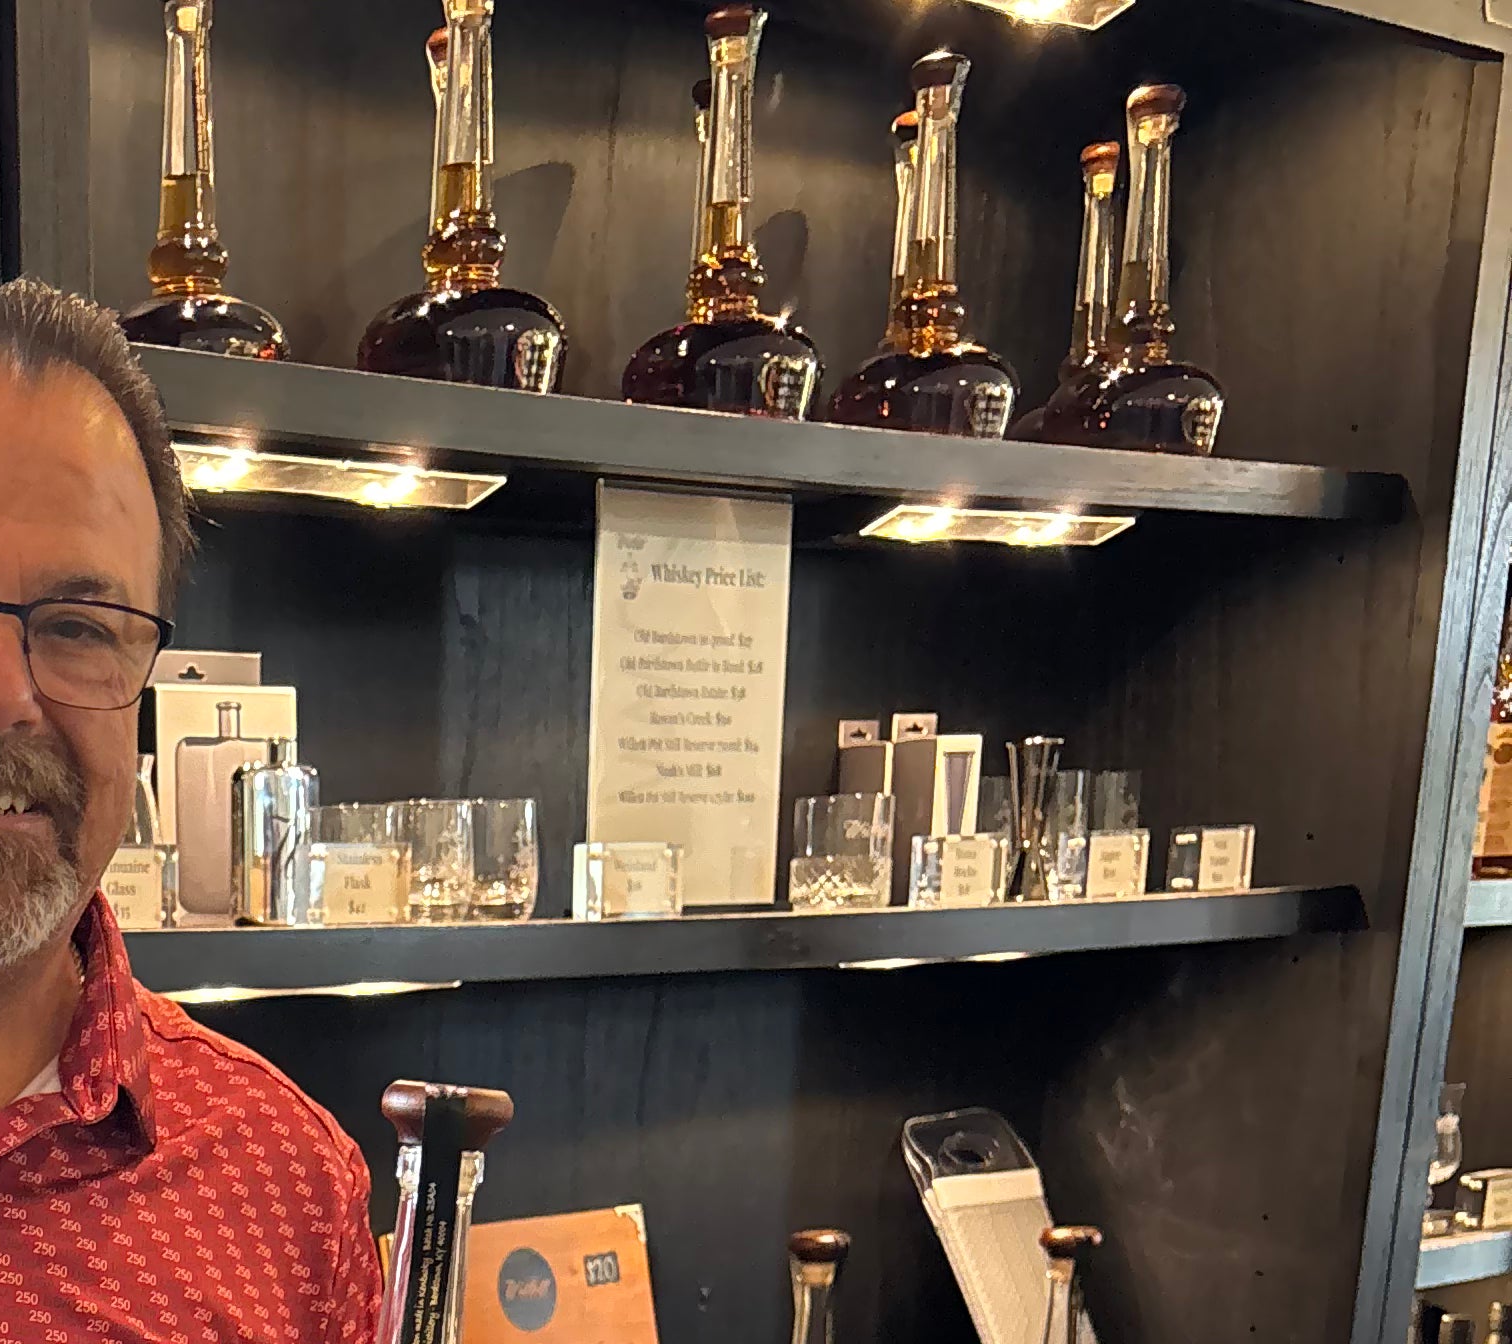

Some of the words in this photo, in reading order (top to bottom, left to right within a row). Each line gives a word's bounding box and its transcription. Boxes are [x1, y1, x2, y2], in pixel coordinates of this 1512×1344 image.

[650, 562, 702, 589] Whiskey
[705, 566, 736, 586] Price
[106, 881, 136, 896] Glass
[86, 1319, 110, 1333] 250
